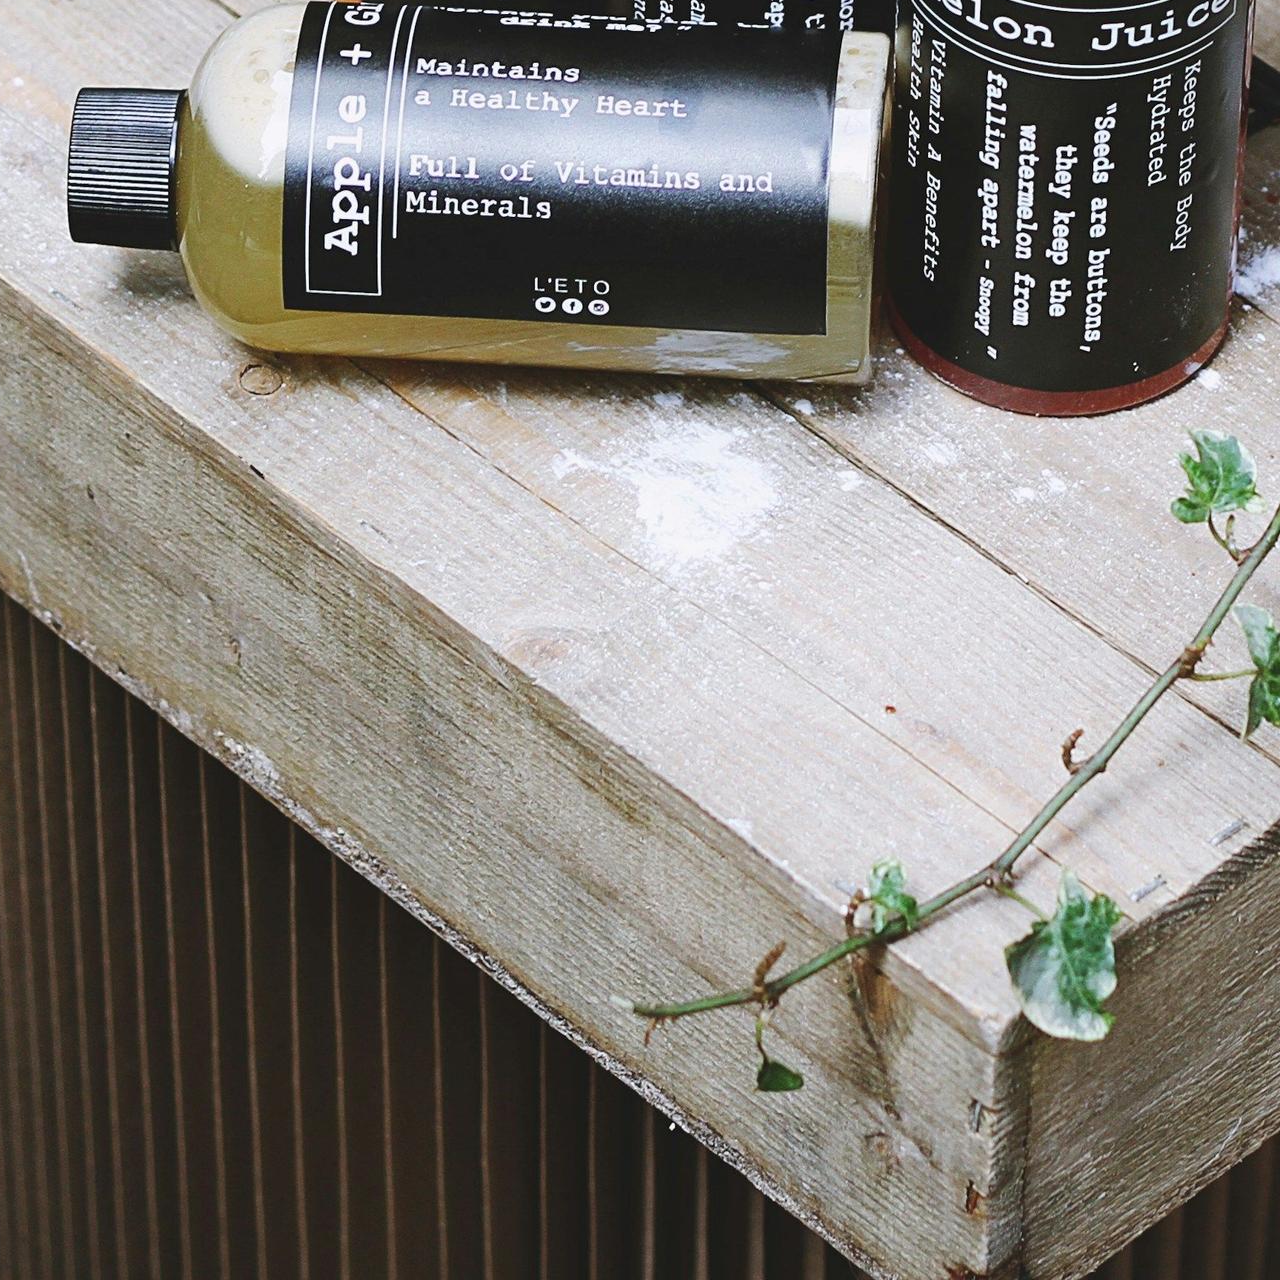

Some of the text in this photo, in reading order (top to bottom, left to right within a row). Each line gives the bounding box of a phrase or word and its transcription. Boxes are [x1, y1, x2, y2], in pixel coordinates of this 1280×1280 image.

[339, 42, 372, 66] +
[805, 13, 826, 30] t
[414, 88, 688, 118] a Healthy Heart
[416, 57, 581, 83] Maintains
[907, 12, 926, 168] Health Skin
[923, 38, 947, 282] Vitamin A Benefits
[978, 70, 1009, 170] falling
[1147, 73, 1172, 187] Hydrated
[1170, 59, 1202, 252] Keeps the Body
[324, 94, 371, 256] Apple
[405, 190, 552, 220] Minerals
[408, 153, 774, 193] Full of Vitamins and
[977, 177, 1001, 249] apart
[1012, 124, 1041, 327] watermelon from
[1045, 143, 1079, 318] they keep the
[1079, 102, 1119, 354] "Seeds are buttons,
[533, 277, 611, 296] L'ETO
[974, 276, 995, 336] Snoopy
